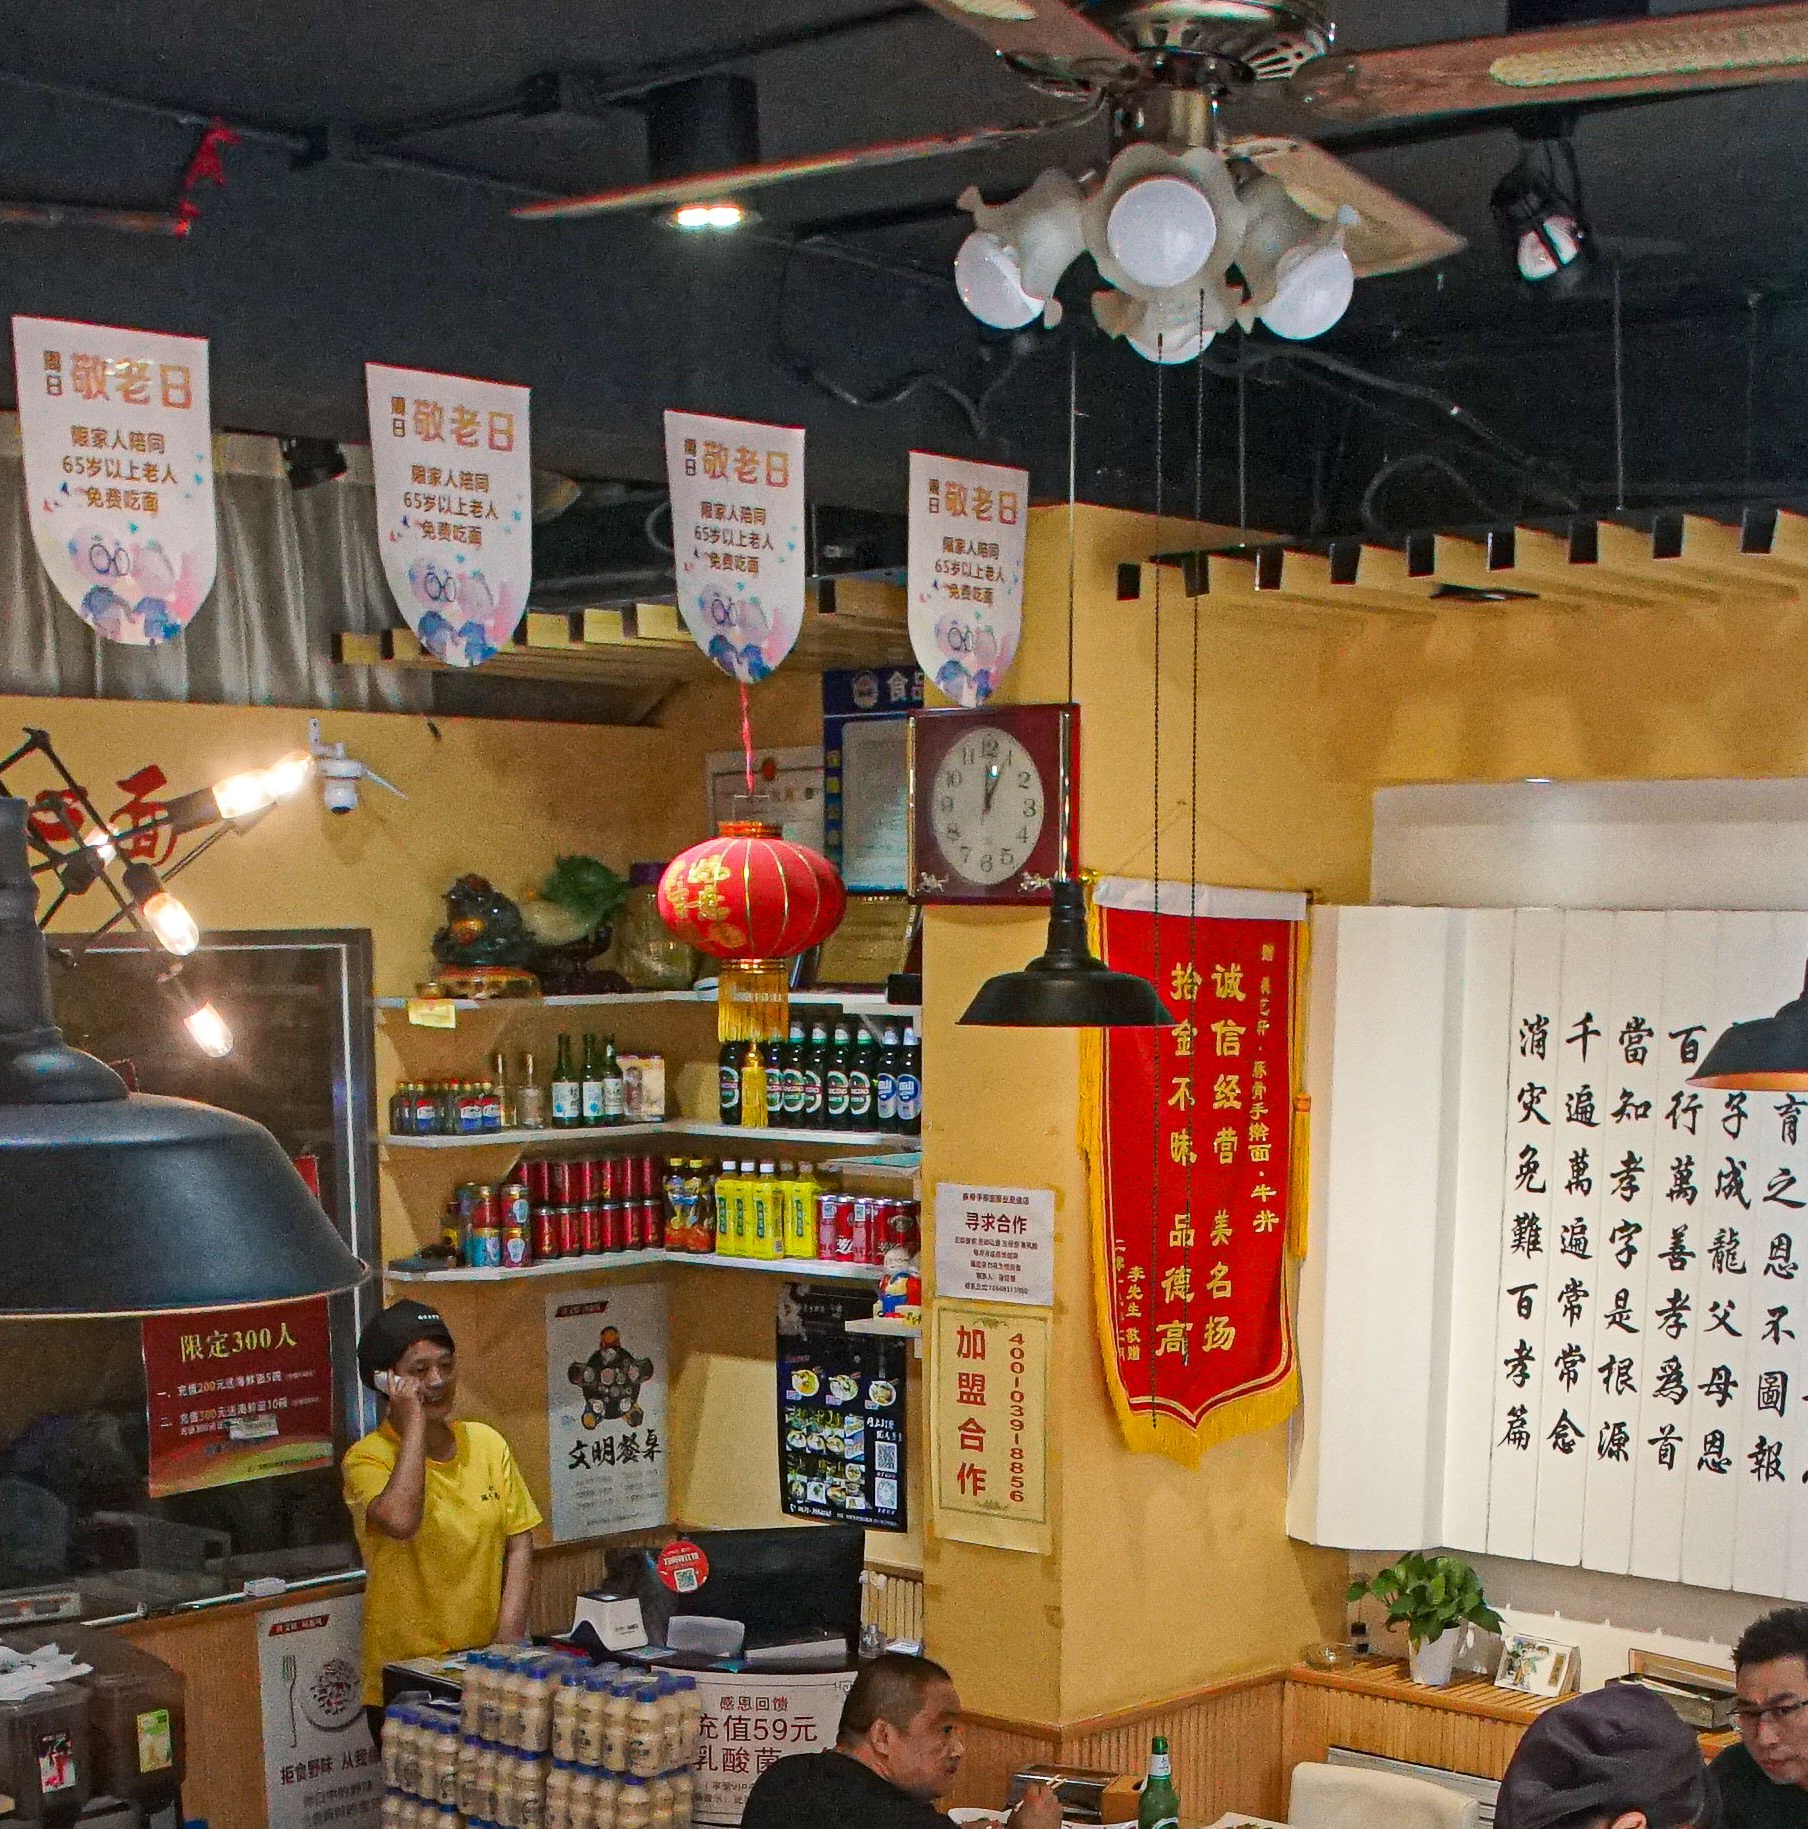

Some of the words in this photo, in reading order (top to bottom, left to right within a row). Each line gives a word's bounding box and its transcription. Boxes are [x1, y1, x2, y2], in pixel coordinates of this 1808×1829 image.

[71, 354, 192, 409] 敬老日
[412, 399, 514, 453] 敬老日
[702, 440, 790, 488] 敬老日
[945, 482, 1019, 525] 敬老日
[962, 748, 975, 766] 11
[945, 770, 962, 787] 10
[1018, 772, 1030, 789] 2
[1023, 799, 1036, 818] 3
[946, 826, 960, 842] 8
[1016, 825, 1029, 843] 4
[959, 846, 971, 863] 7
[980, 854, 992, 873] 6
[1000, 848, 1013, 865] 5
[965, 1211, 1028, 1235] 寻求合作
[1697, 1094, 1752, 1475] 子成龍父母恩
[1747, 1096, 1807, 1482] 育之恩不圖報
[179, 1322, 298, 1363] 限定300人
[956, 1325, 987, 1497] 加盟合作
[568, 1429, 662, 1470] 文明餐桌
[720, 1696, 789, 1712] 感恩回馈
[698, 1713, 818, 1743] 充值59元
[281, 1755, 334, 1786] 拒食野味
